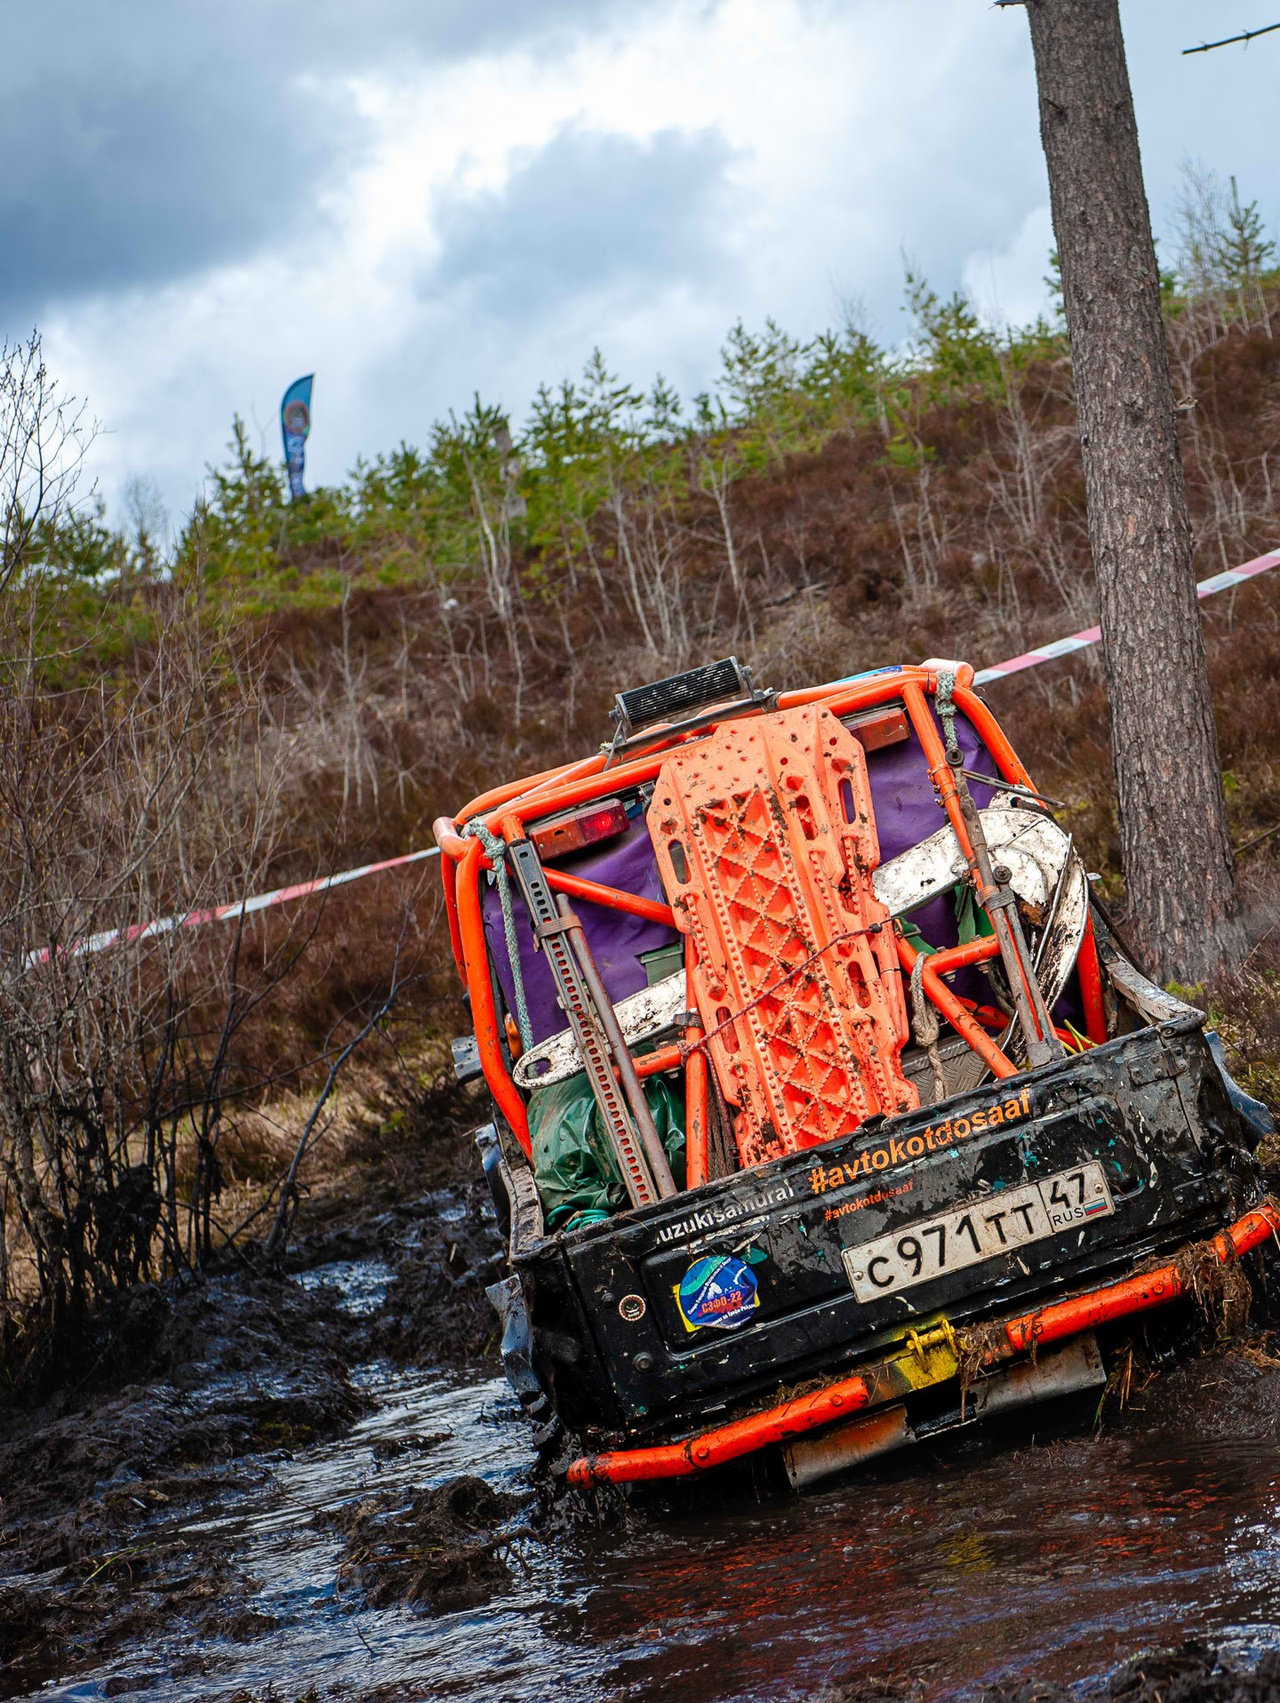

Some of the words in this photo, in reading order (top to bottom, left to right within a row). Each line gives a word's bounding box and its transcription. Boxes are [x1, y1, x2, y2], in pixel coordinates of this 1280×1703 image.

[808, 1087, 1031, 1195] #avtokotdosaaf
[1050, 1172, 1085, 1209] 47
[1053, 1208, 1084, 1227] RUS
